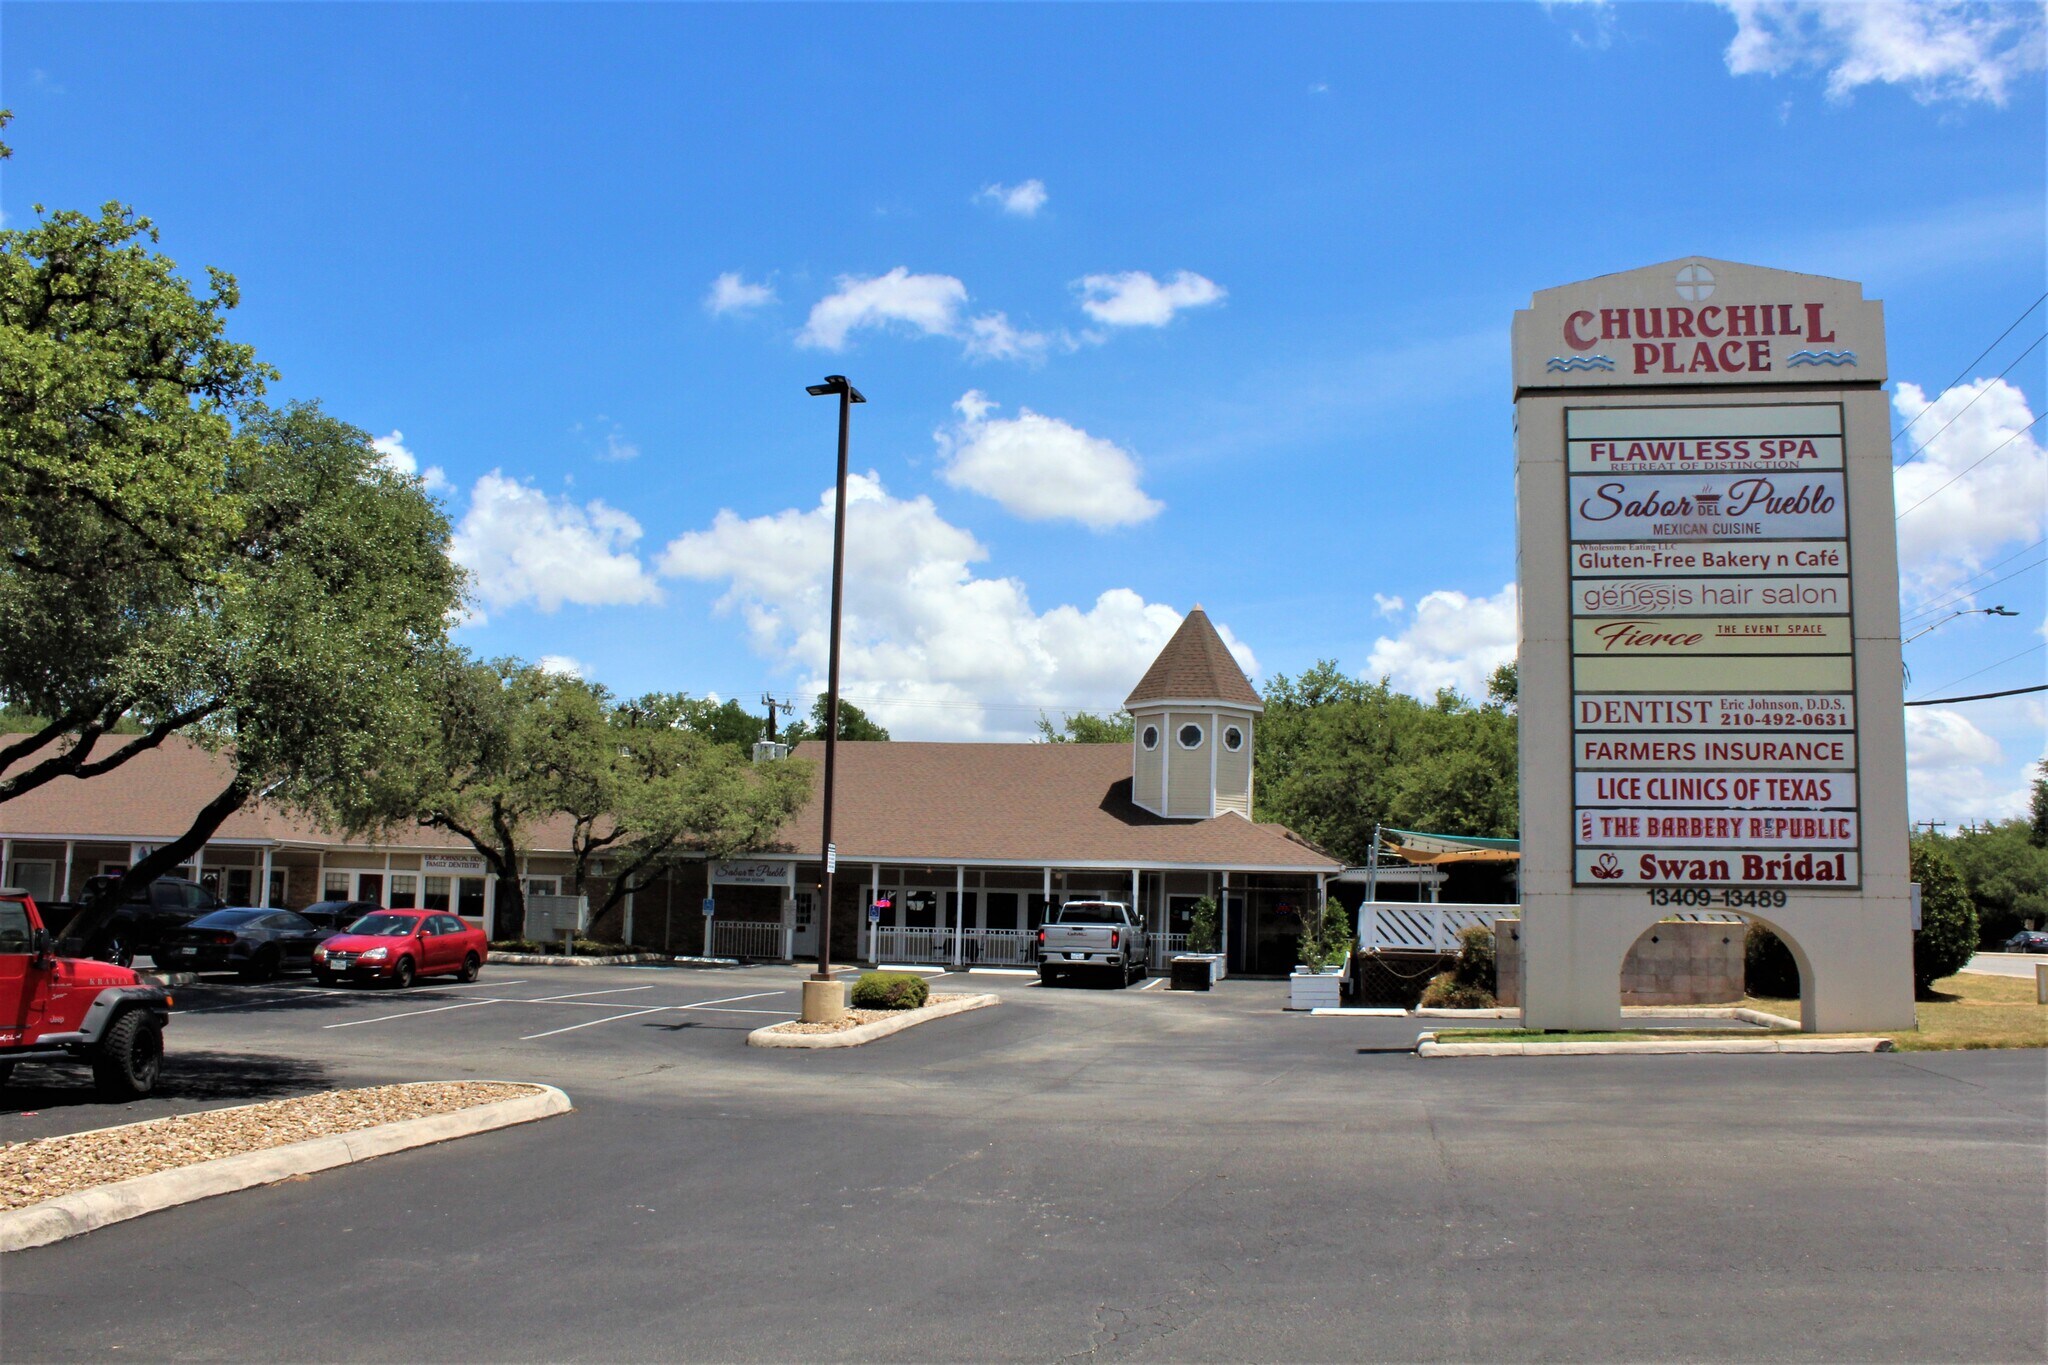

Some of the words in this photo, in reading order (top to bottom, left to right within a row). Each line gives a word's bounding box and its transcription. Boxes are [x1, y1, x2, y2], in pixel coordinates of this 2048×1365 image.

[1563, 303, 1835, 351] CHURCHILL
[1633, 340, 1772, 374] PLACE
[1590, 441, 1751, 462] FLAWLESS
[1759, 439, 1819, 459] SPA
[1610, 462, 1676, 472] RETREAT
[1680, 461, 1699, 471] OF
[1704, 460, 1801, 470] DISTINCTION
[1579, 483, 1693, 521] Sabor
[1698, 504, 1721, 516] DEL
[1726, 477, 1835, 517] Pueblo
[1653, 523, 1708, 535] MEXICAN
[1712, 522, 1762, 535] CUISINE
[1580, 543, 1627, 551] Wholesome
[1629, 543, 1656, 552] Eating
[1658, 542, 1678, 551] LLC
[1579, 552, 1696, 569] Gluten-Free
[1702, 551, 1770, 571] Bakery
[1777, 554, 1789, 567] n
[1795, 549, 1839, 567] Café
[1584, 584, 1693, 610] genesis
[1701, 584, 1753, 605] hair
[1762, 583, 1837, 604] salon
[1594, 621, 1704, 651] Fierce
[1718, 625, 1737, 634] THE
[1745, 624, 1779, 634] EVENT
[1788, 624, 1823, 634] SPACE
[1581, 700, 1713, 724] DENTIST
[1720, 699, 1744, 711] Eric
[1747, 698, 1804, 712] Johnson,
[1806, 698, 1846, 710] D.D.S.
[1720, 713, 1847, 726] 210-492-0631
[1584, 742, 1697, 761] FARMERS
[1704, 741, 1844, 761] INSURANCE
[1597, 777, 1640, 800] LICE
[1647, 777, 1728, 801] CLINICS
[1734, 778, 1760, 801] OF
[1765, 778, 1831, 801] TEXAS
[1599, 817, 1640, 839] THE
[1647, 817, 1745, 839] BARBERY
[1749, 817, 1851, 839] REPUBLIC
[715, 865, 746, 877] Sabor
[1640, 854, 1730, 881] Swan
[1742, 853, 1847, 882] Bridal
[1646, 888, 1788, 907] 13409-13489
[49, 1015, 65, 1023] Jeep
